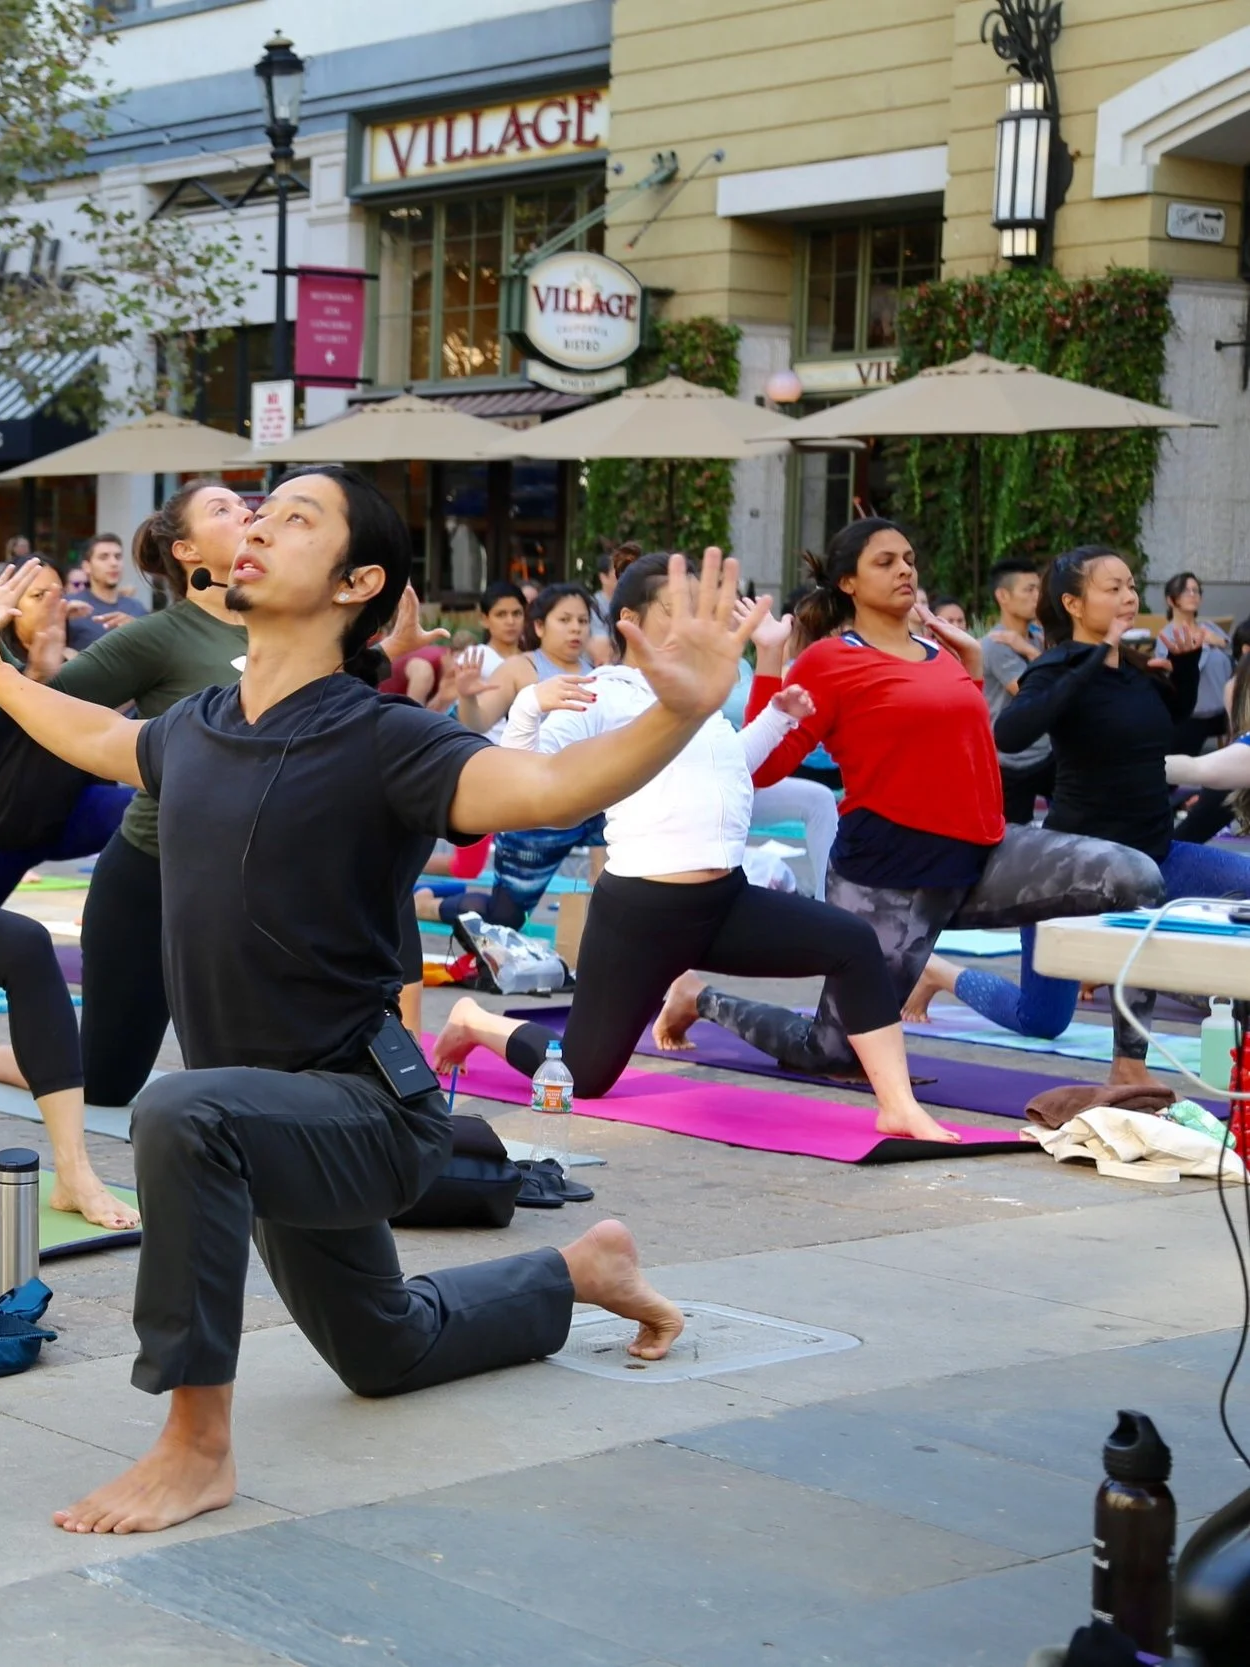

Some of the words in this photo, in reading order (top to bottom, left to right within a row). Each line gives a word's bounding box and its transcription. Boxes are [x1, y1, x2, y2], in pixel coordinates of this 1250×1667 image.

[383, 88, 605, 180] VILLAGE
[532, 284, 638, 323] VILLAGE
[564, 339, 601, 353] BISTRO
